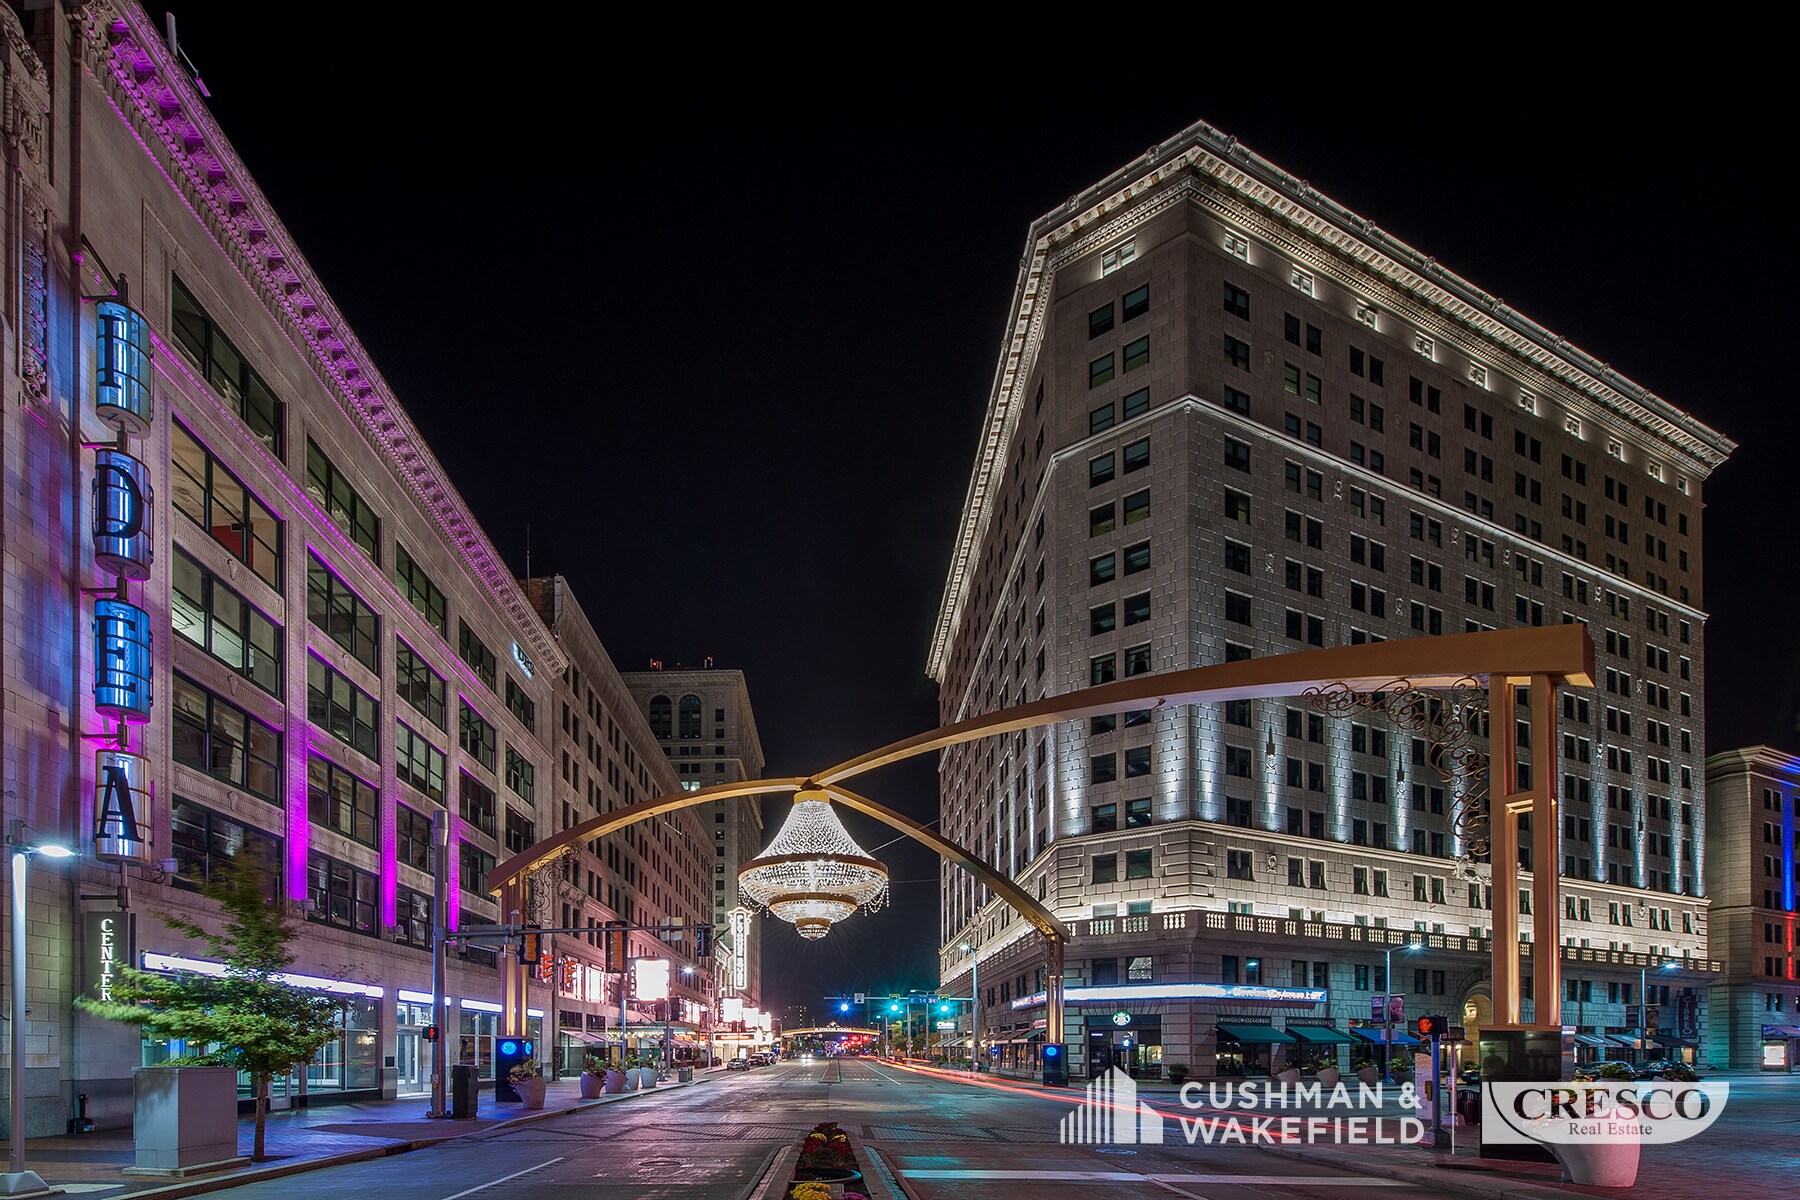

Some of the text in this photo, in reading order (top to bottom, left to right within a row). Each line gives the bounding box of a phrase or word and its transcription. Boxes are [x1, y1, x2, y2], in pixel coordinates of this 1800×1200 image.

[93, 314, 144, 1002] IDEA CENTER
[1682, 996, 1693, 1035] CIBREO
